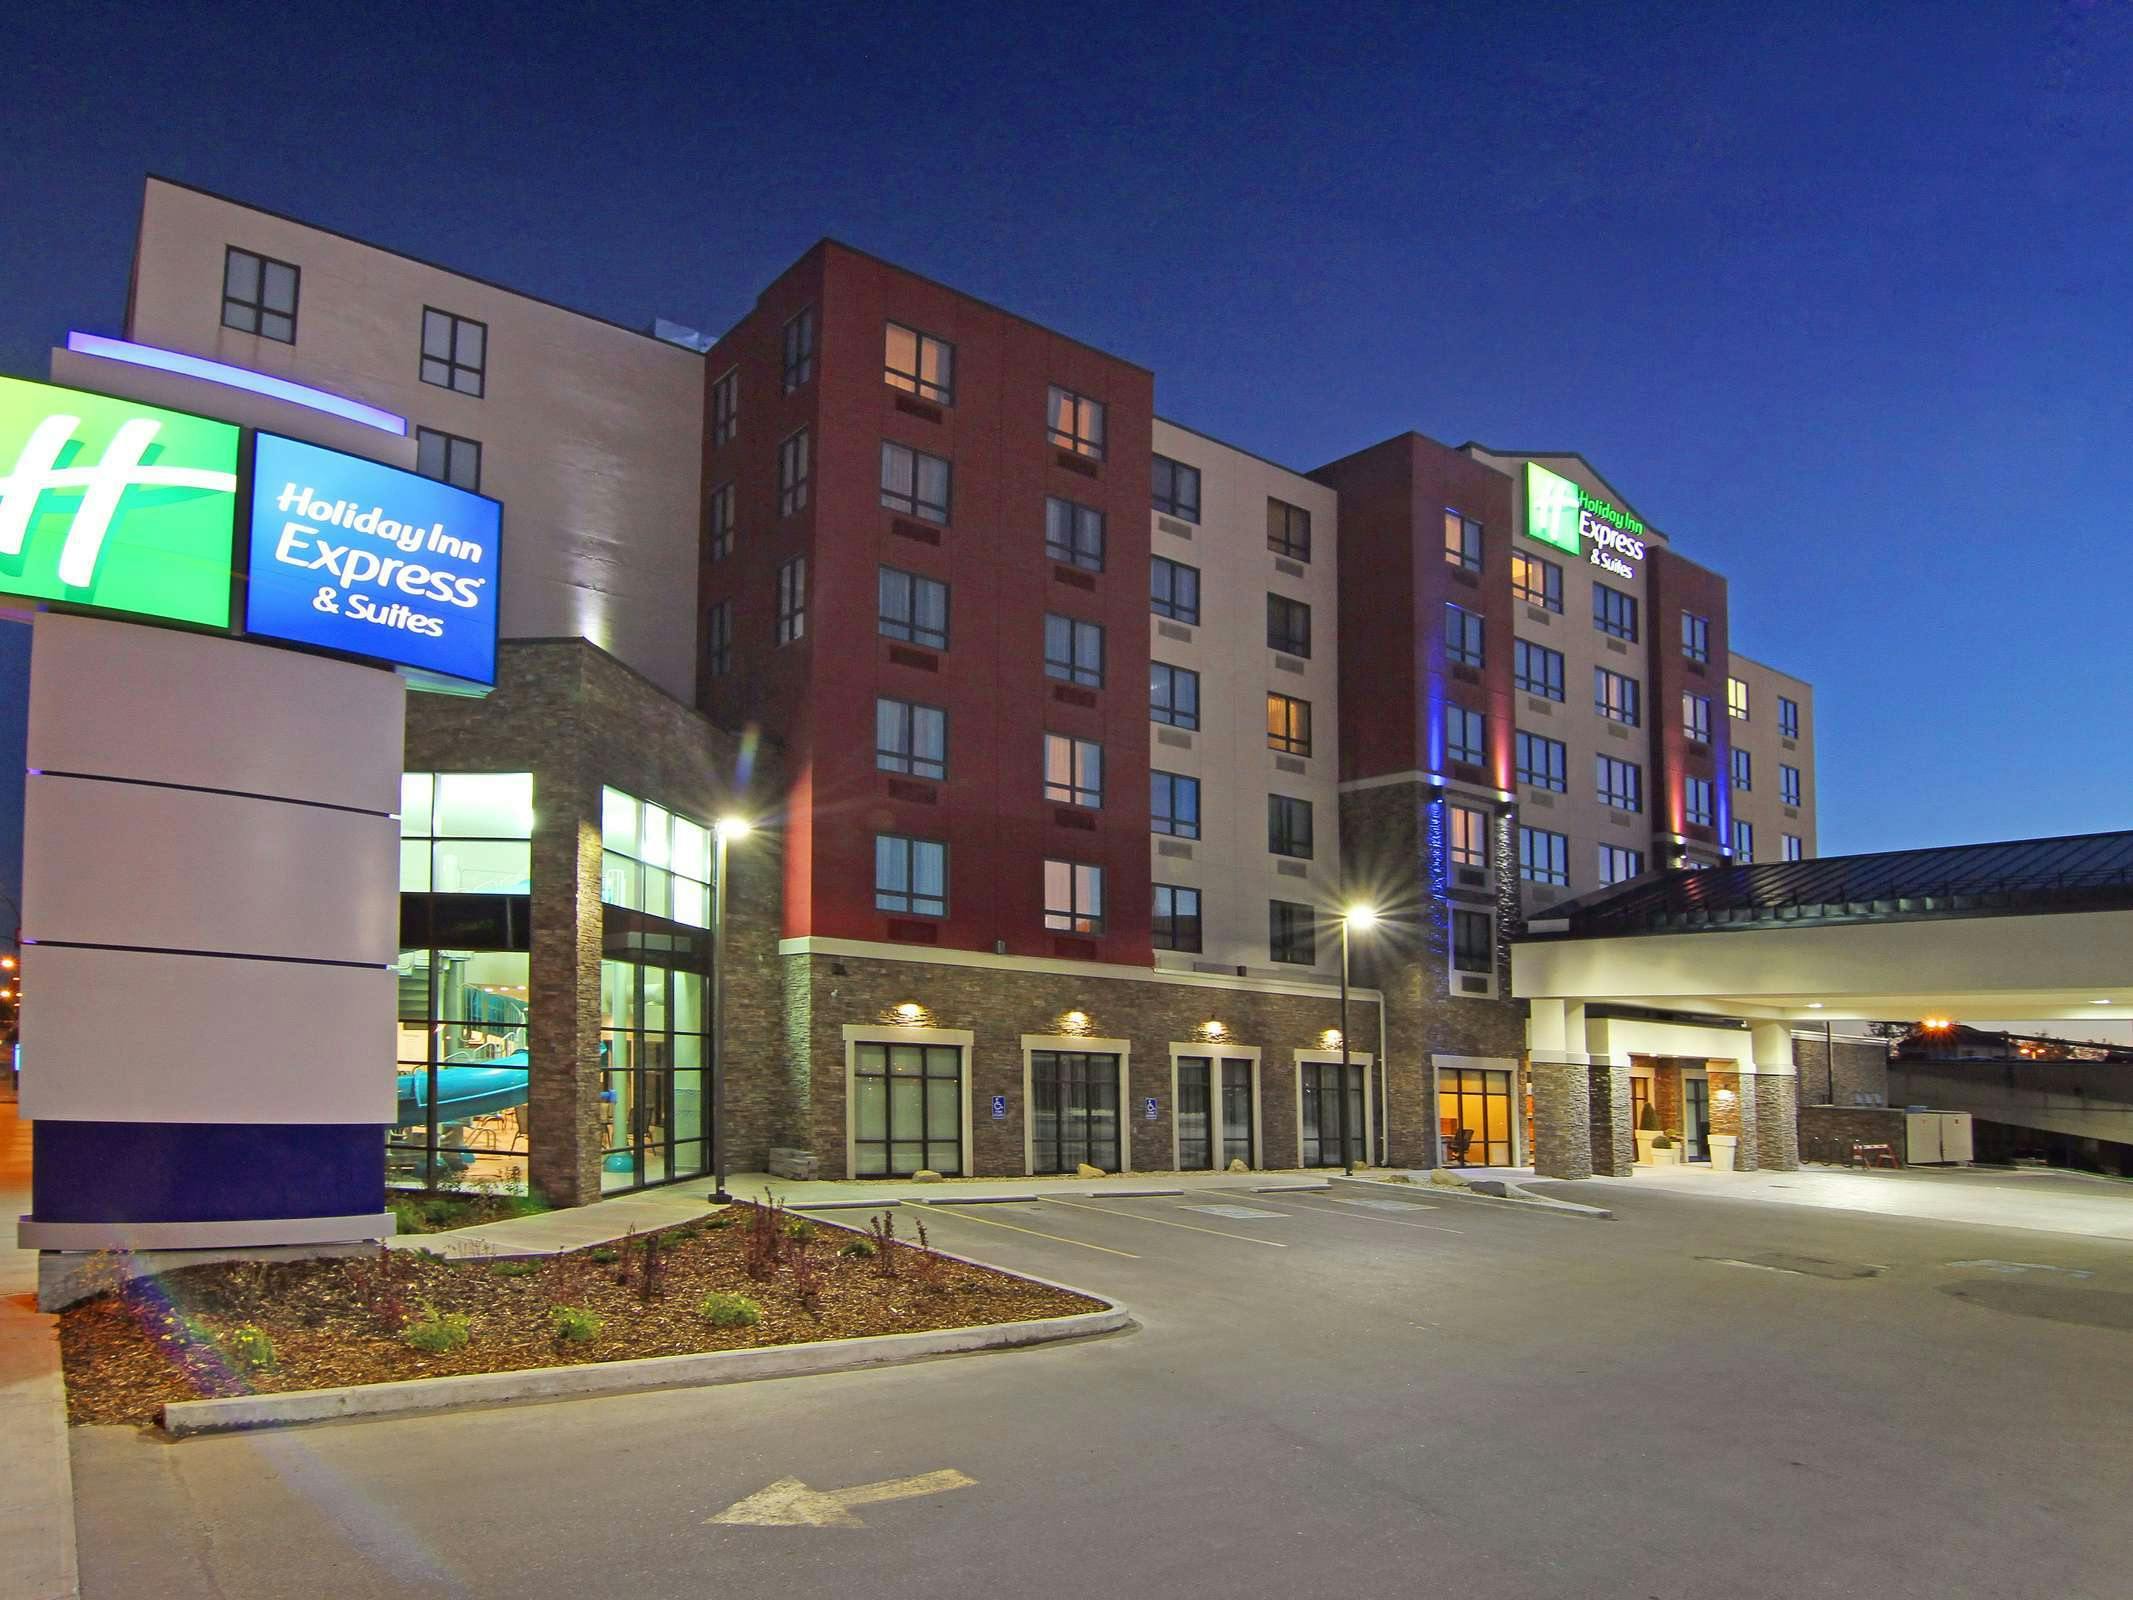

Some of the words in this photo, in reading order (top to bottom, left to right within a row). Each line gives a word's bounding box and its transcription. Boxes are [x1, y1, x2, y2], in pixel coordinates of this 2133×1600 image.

[276, 482, 425, 552] Holiday
[427, 523, 483, 563] Inn
[1579, 510, 1645, 560] Express
[1580, 490, 1624, 529] Holiday
[1625, 512, 1644, 536] Inn
[275, 521, 480, 608] Express
[1591, 548, 1601, 565] &
[1601, 553, 1633, 579] Suites
[312, 586, 340, 614] &
[345, 594, 444, 637] Suites
